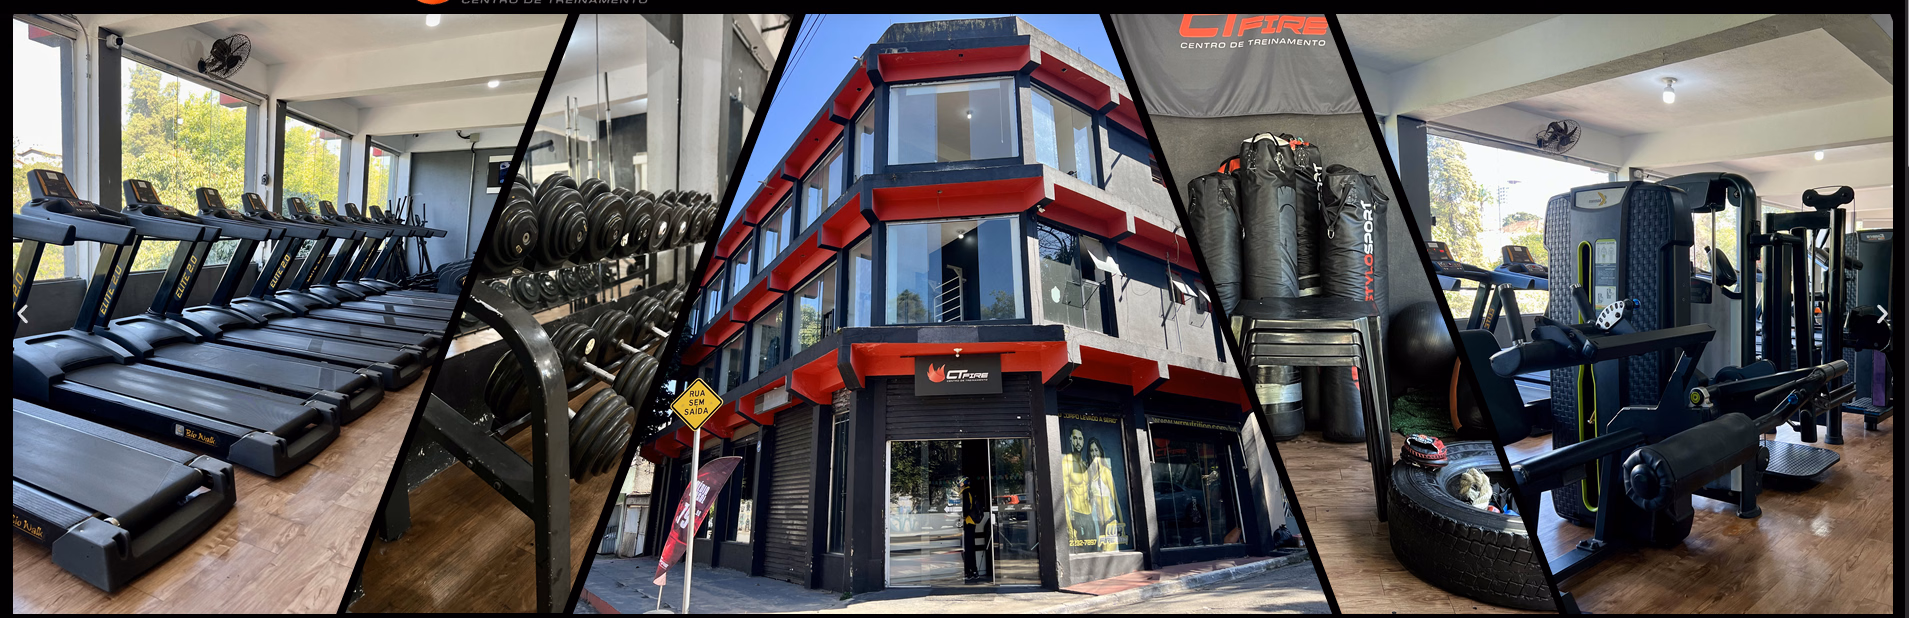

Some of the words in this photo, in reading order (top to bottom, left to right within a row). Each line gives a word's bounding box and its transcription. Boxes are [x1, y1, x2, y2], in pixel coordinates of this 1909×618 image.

[1248, 38, 1326, 46] TREINAMENTO
[175, 273, 190, 299] ELITE
[187, 255, 198, 274] 2.0
[269, 267, 283, 289] ELITE
[100, 286, 115, 316] ELITE
[111, 264, 123, 287] 2.0
[690, 390, 706, 398] RUA
[689, 399, 705, 407] SEM
[684, 406, 709, 415] SAÍDA
[185, 429, 198, 438] Bio
